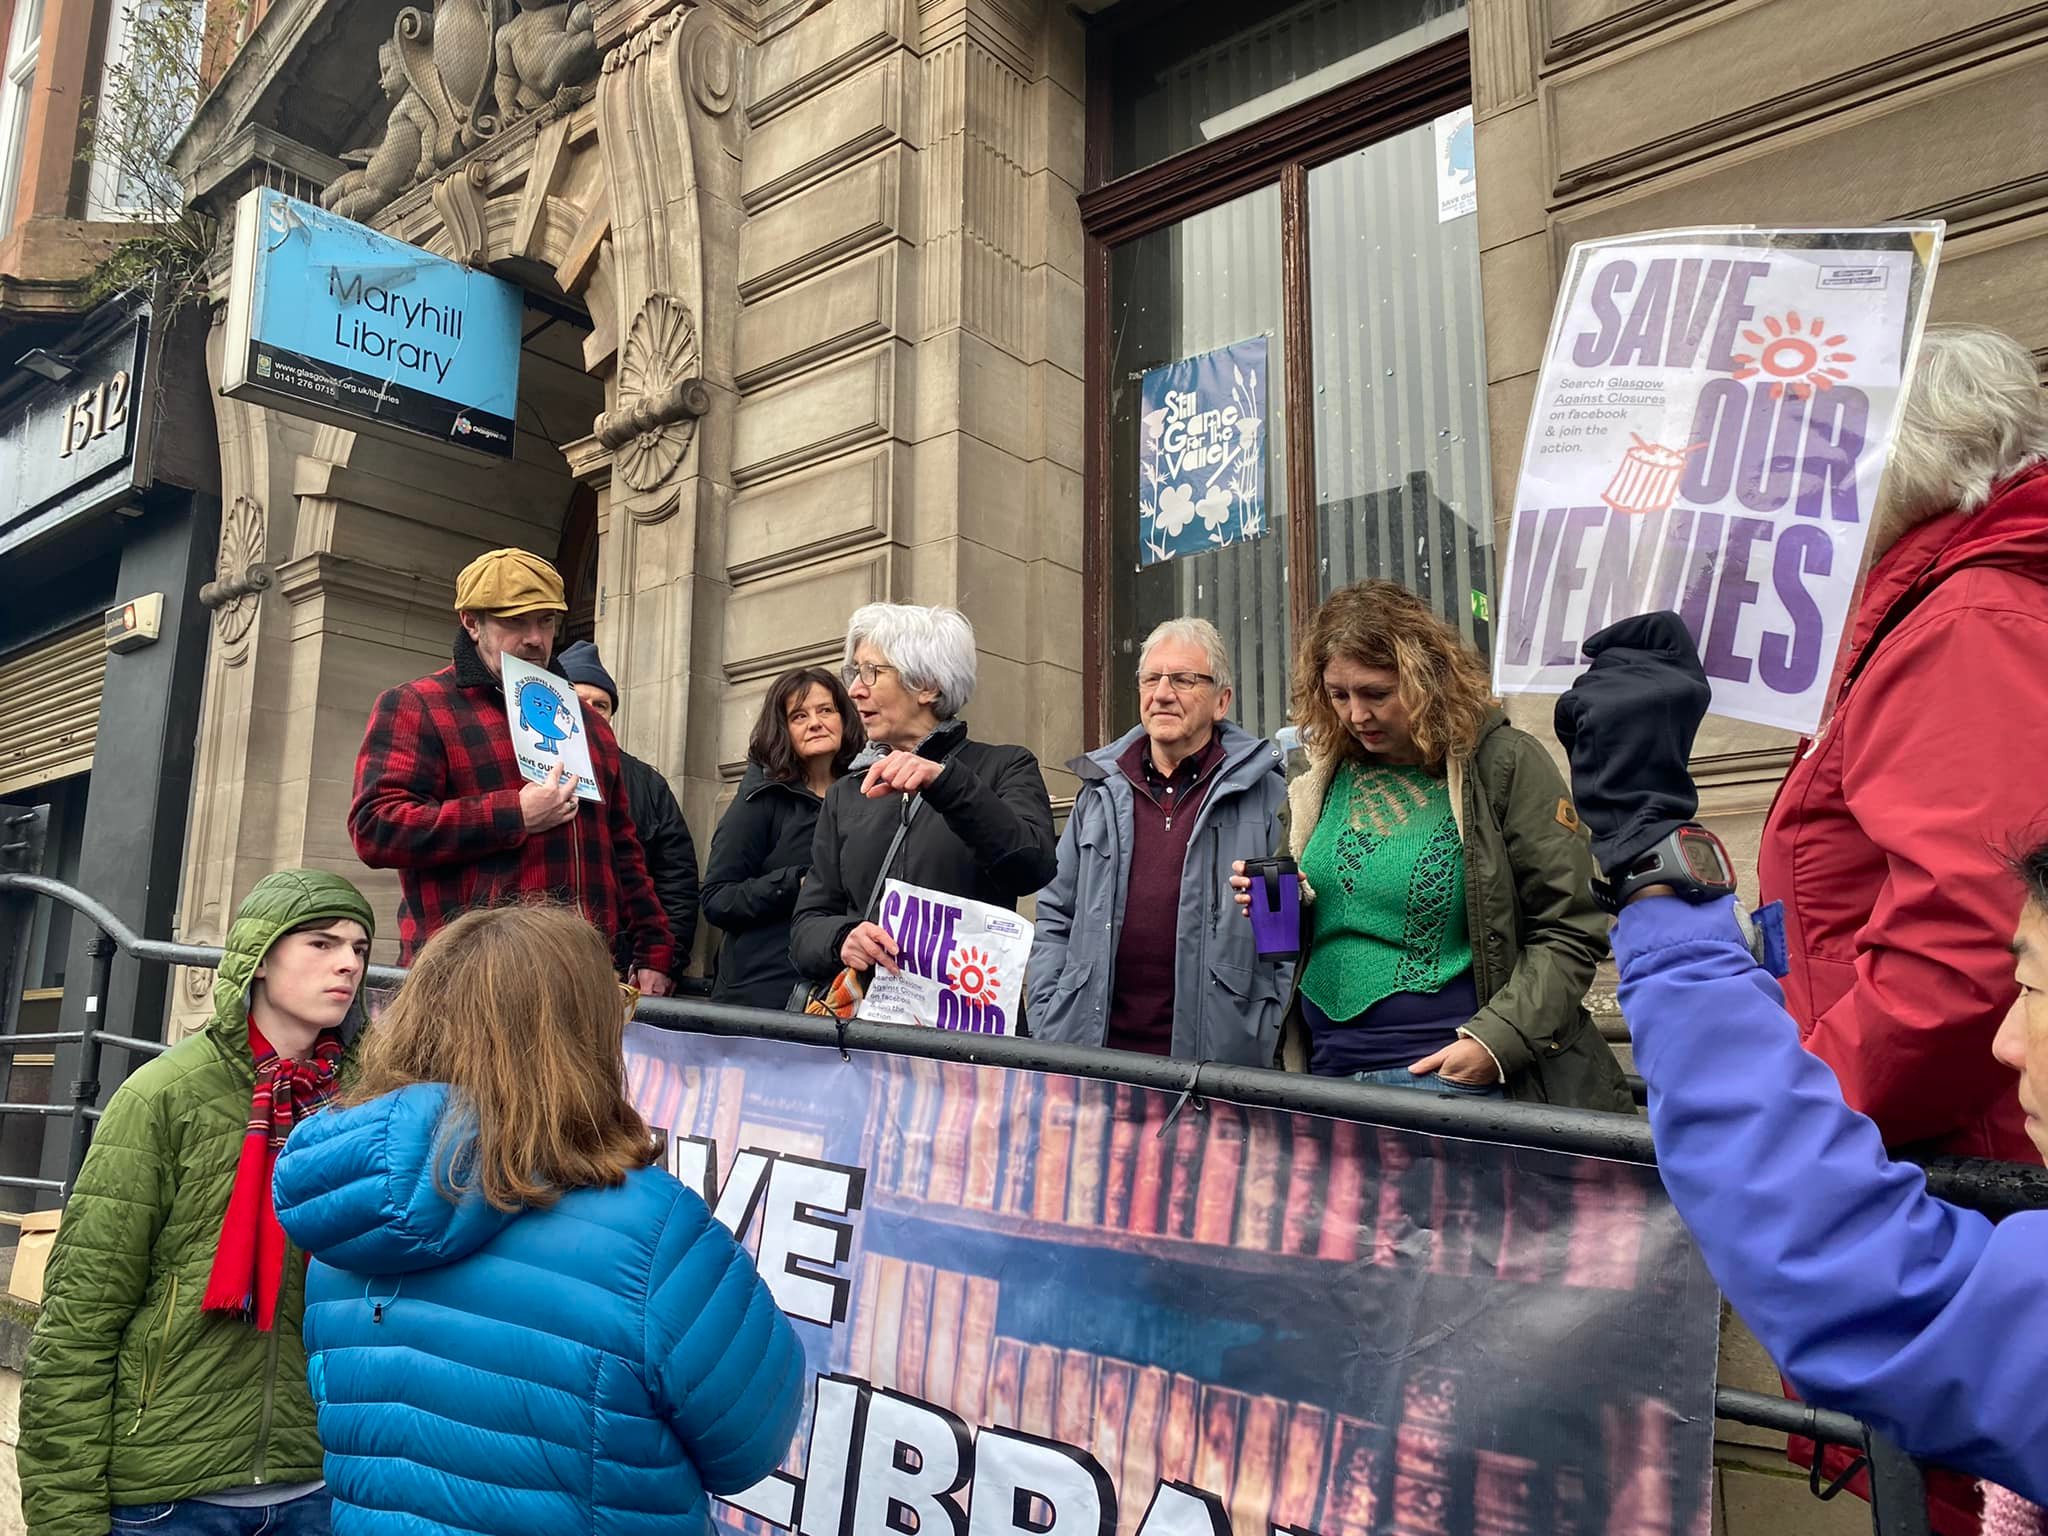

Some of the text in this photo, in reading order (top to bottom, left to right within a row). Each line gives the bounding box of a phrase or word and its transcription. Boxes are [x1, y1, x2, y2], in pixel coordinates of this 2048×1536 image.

[329, 265, 462, 340] Maryhill
[1572, 258, 1770, 371] SAVE
[335, 314, 453, 385] Library
[274, 361, 400, 405] www.glasgow.org.uk/libraries
[274, 371, 336, 396] 0141 276 0715
[1554, 392, 1666, 405] Against Closures
[1560, 377, 1664, 390] Search Glasgow
[59, 370, 130, 459] 1512
[1163, 406, 1239, 453] Game
[1164, 390, 1197, 424] Still
[1549, 408, 1628, 420] on facebook
[1540, 441, 1583, 454] action.
[1545, 424, 1608, 438] & join the
[1679, 378, 1869, 523] OUR
[1165, 442, 1242, 488] Valley
[1504, 507, 1834, 694] VENUES
[882, 890, 962, 985] SAVE
[650, 1125, 867, 1328] VE
[712, 1371, 1318, 1536] IBR
